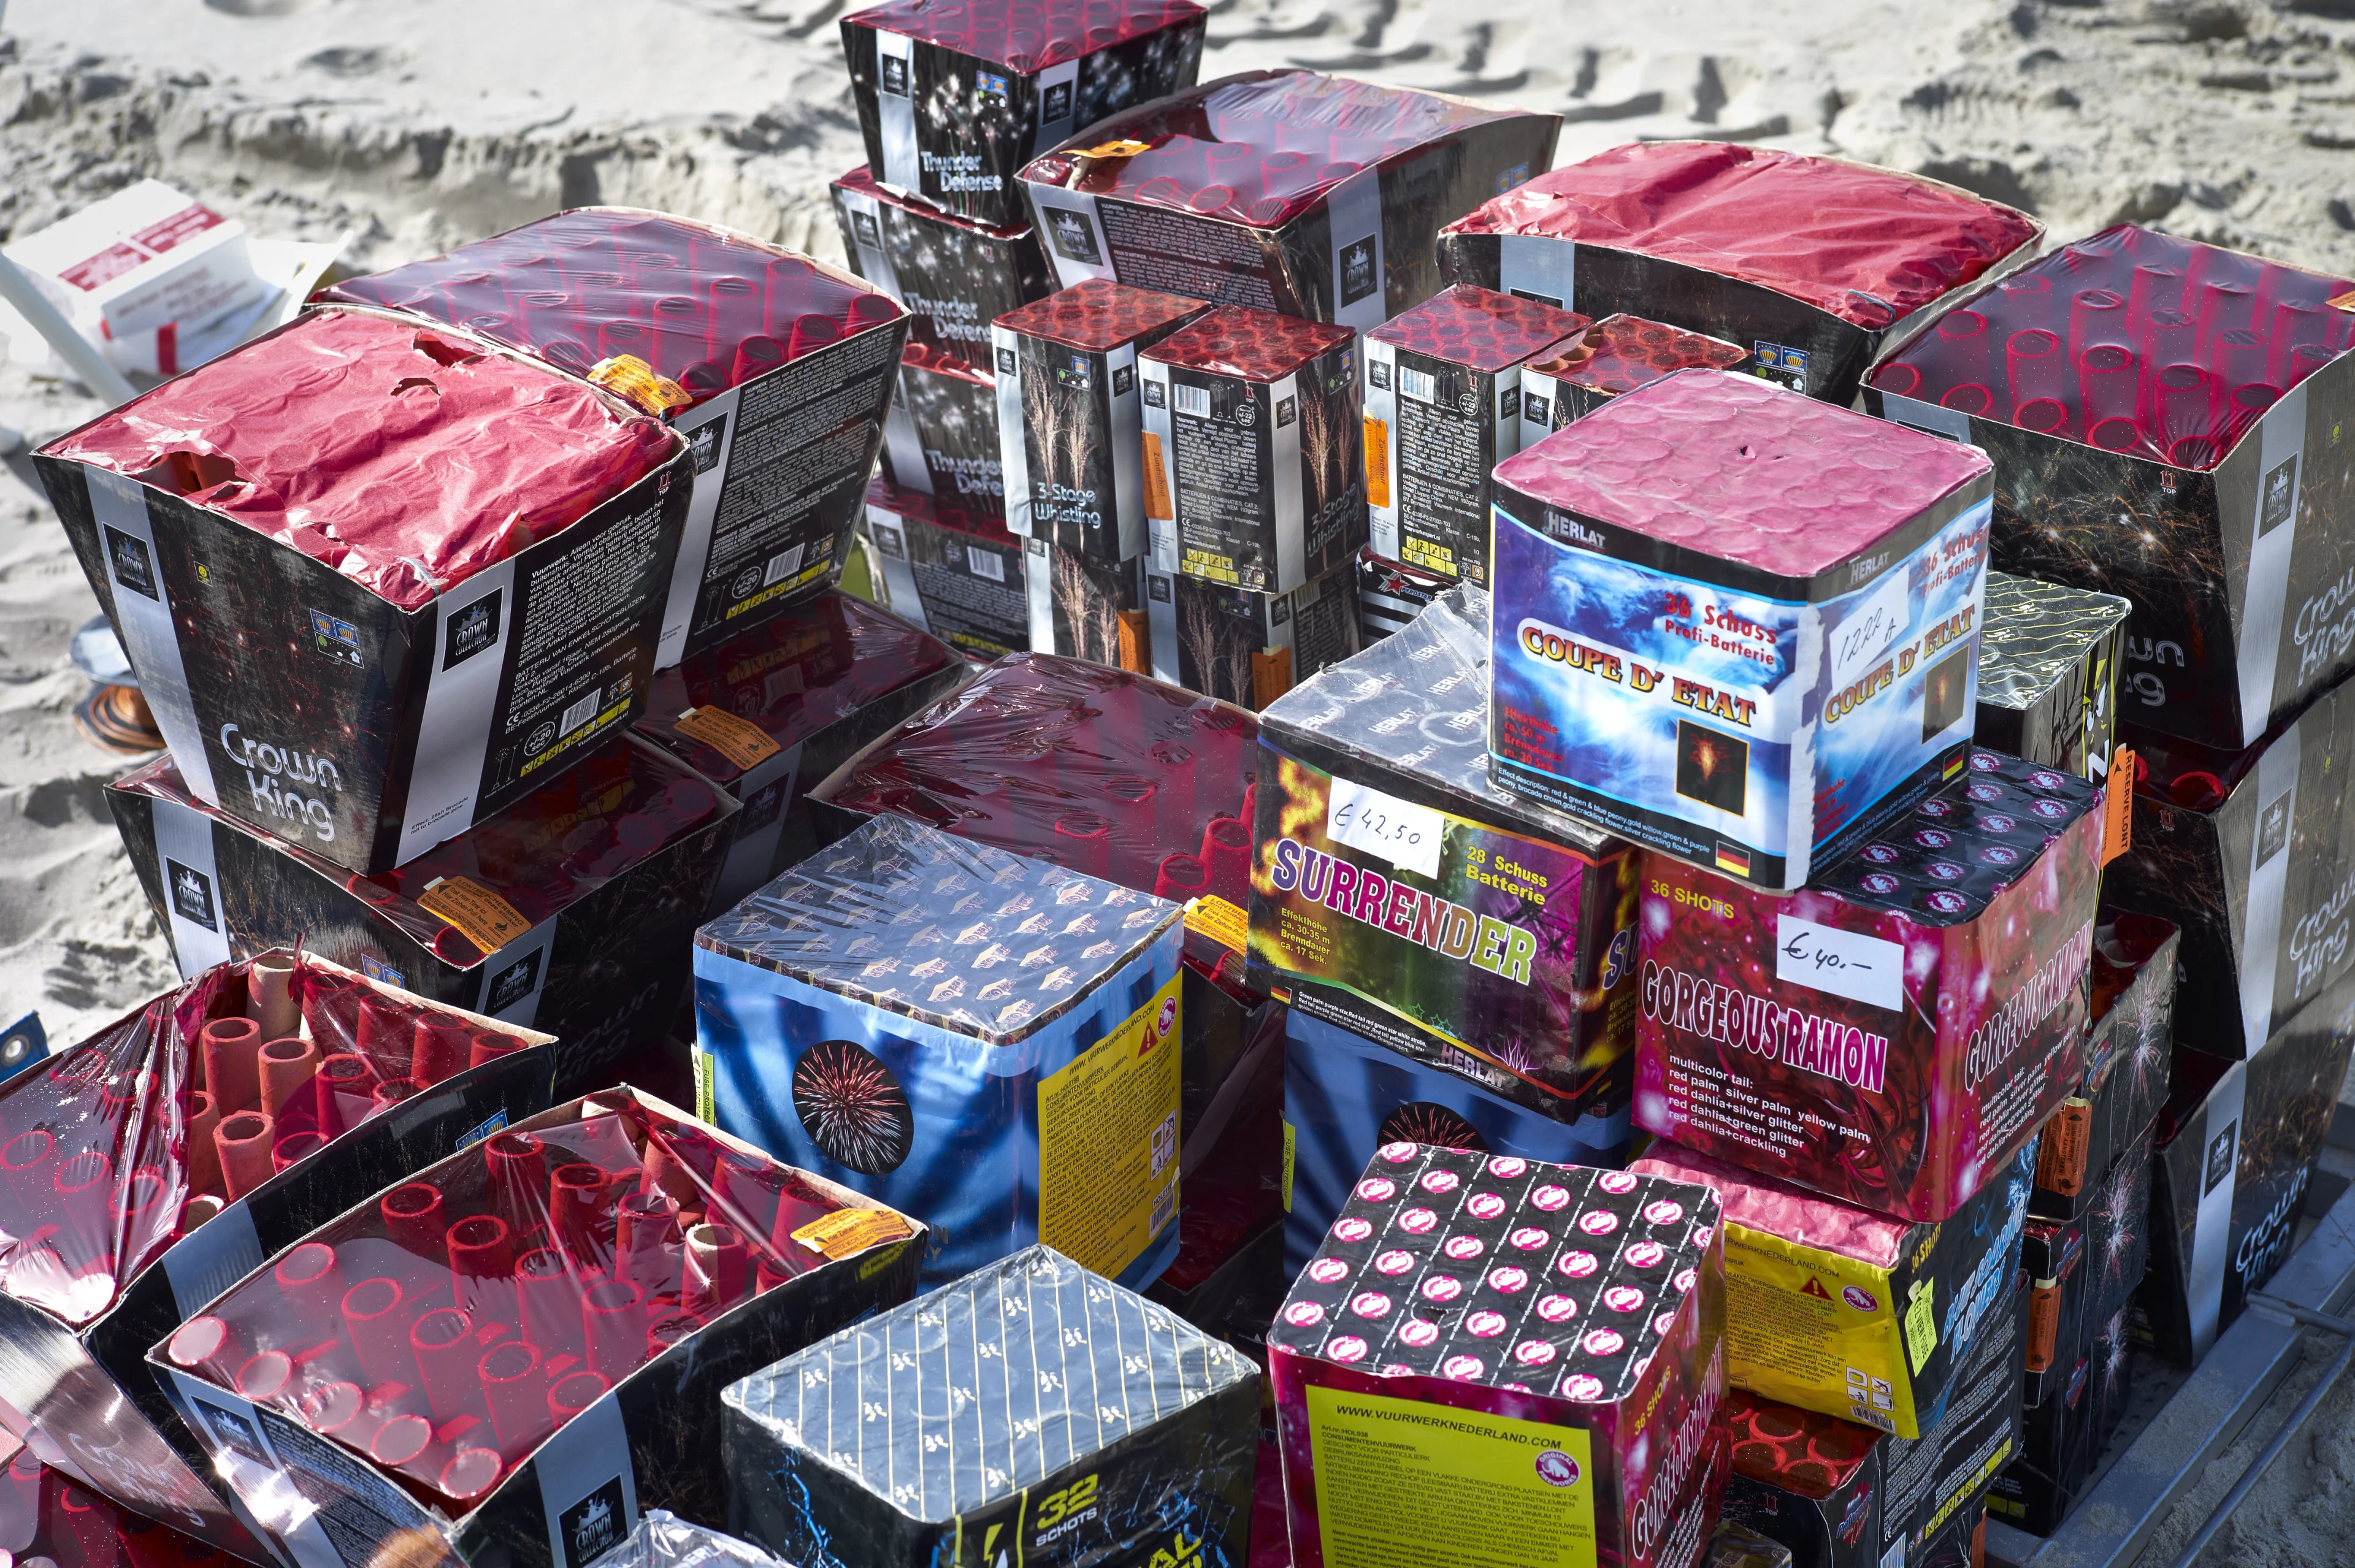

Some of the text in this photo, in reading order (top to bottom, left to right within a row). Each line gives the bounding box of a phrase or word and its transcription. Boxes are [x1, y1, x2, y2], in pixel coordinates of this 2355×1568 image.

[921, 150, 982, 172] Thunder
[940, 172, 1003, 192] Defense
[904, 291, 978, 319] Thunder
[933, 316, 992, 342] Defens
[659, 486, 670, 496] TOP
[1154, 453, 1165, 497] Zündschnur
[1037, 482, 1096, 507] 3-Stage
[1312, 483, 1356, 534] 3-Stage
[2268, 486, 2288, 510] CROWN
[628, 516, 652, 536] rechtop
[1035, 503, 1101, 529] Whistling
[1308, 503, 1359, 557] Whistling
[1455, 508, 1480, 519] International
[1548, 511, 1606, 549] HERLAT
[532, 514, 632, 578] Vuurwerk: Alleen voor gebruik
[573, 499, 664, 562] Vermijd obstructies het
[1404, 524, 1441, 541] vuurwerkexpert.nl
[118, 553, 144, 576] CROWN
[1850, 551, 1890, 584] HERLAT
[1924, 552, 1938, 578] 36
[1401, 586, 1432, 601] PYROSTAR
[457, 618, 488, 646] CROWN
[568, 594, 646, 649] ENKELSCHOTSBUIZEN.
[1664, 592, 1777, 644] 36 Schuss
[1884, 618, 1896, 643] A
[455, 632, 487, 656] COLLECTION
[1664, 619, 1775, 666] Profi-Batterie
[1837, 607, 1882, 671] 1222
[516, 654, 551, 681] BATTERIJ
[613, 646, 638, 666] Batterie.
[628, 654, 636, 662] 10
[1825, 603, 1975, 724] COUPE ETAT
[1522, 625, 1757, 728] COUPE D' ETAT
[578, 711, 629, 748] Vuurwerkexpert.nl
[1368, 708, 1419, 735] HERLAT
[1504, 706, 1558, 735] Effekthöhe
[1504, 722, 1545, 743] ca. 50 m
[529, 730, 551, 748] +/-20
[531, 740, 546, 752] sec
[1504, 732, 1563, 762] Brenndauer
[220, 723, 342, 792] Crown
[1504, 748, 1556, 774] ca. 30 Sek.
[1498, 767, 1607, 815] Effect description: red green blue
[1518, 783, 1543, 799] brocade
[2123, 755, 2132, 813] RESERVE
[246, 769, 335, 842] King
[445, 796, 469, 813] Brocade
[1334, 803, 1421, 845] € 42,50
[1466, 846, 1548, 889] 28 Schuss
[179, 885, 205, 909] CROWN
[1465, 863, 1546, 906] Batterie
[1651, 879, 1735, 919] 36 SHOTS
[458, 879, 524, 926] LONTBESCHERMING
[1271, 837, 1537, 987] SURRENDER
[2289, 870, 2355, 962] Crow
[1214, 919, 1244, 937] Ziehen-Pull
[1281, 920, 1330, 944] ca. 30-35 m
[1282, 908, 1327, 933] Effekthöhe
[1281, 928, 1330, 955] Brenndauer
[1281, 941, 1327, 965] ca. 17 Sek.
[1781, 931, 1810, 959] €
[2294, 917, 2349, 1000] King
[496, 972, 529, 1000] CROWN
[1964, 968, 2043, 1092] GORGEOUS
[2042, 919, 2091, 1022] RAMON
[1641, 958, 1780, 1060] GORGEOUS
[1782, 1007, 1888, 1094] RAMON
[1441, 1043, 1505, 1089] HERLAT
[1669, 1054, 1753, 1088] multicolor tail:
[1046, 1065, 1104, 1111] CONSUMENTENVUURWERK
[1669, 1068, 1836, 1131] red palm silver palm yellow
[1980, 1076, 2015, 1115] multicolor
[1669, 1082, 1804, 1134] red dahlia+silver glitter
[1669, 1095, 1804, 1149] red dahlia+green glitter
[1669, 1109, 1786, 1158] red dahlia+crackling
[2236, 1165, 2308, 1272] Crown
[1920, 1222, 1942, 1264] SHOTS
[1942, 1269, 1976, 1346] BLUE
[1970, 1193, 2024, 1299] SOARING
[1748, 1277, 1814, 1301] ONDERGROND PLAATSEN
[1950, 1256, 2006, 1365] FLOWERS
[1769, 1330, 1790, 1340] JONGER
[1634, 1365, 1671, 1436] 36 SHOTS
[1321, 1424, 1369, 1438] Art.nr.:HOL038
[1322, 1431, 1417, 1451] CONSUMENTENVUURWERK
[1336, 1404, 1562, 1450] WWW.VUURWERKNEDERLAND.COM
[1323, 1445, 1401, 1464] GEBRUIKSAANWIJZING
[1380, 1447, 1431, 1462] PARTICULIERK
[1632, 1335, 1722, 1561] GORGEOUS RAMON
[1036, 1473, 1098, 1530] 32
[576, 1513, 612, 1550] CROWN
[1036, 1507, 1097, 1547] SCHOTS
[578, 1530, 613, 1563] COLLECTION
